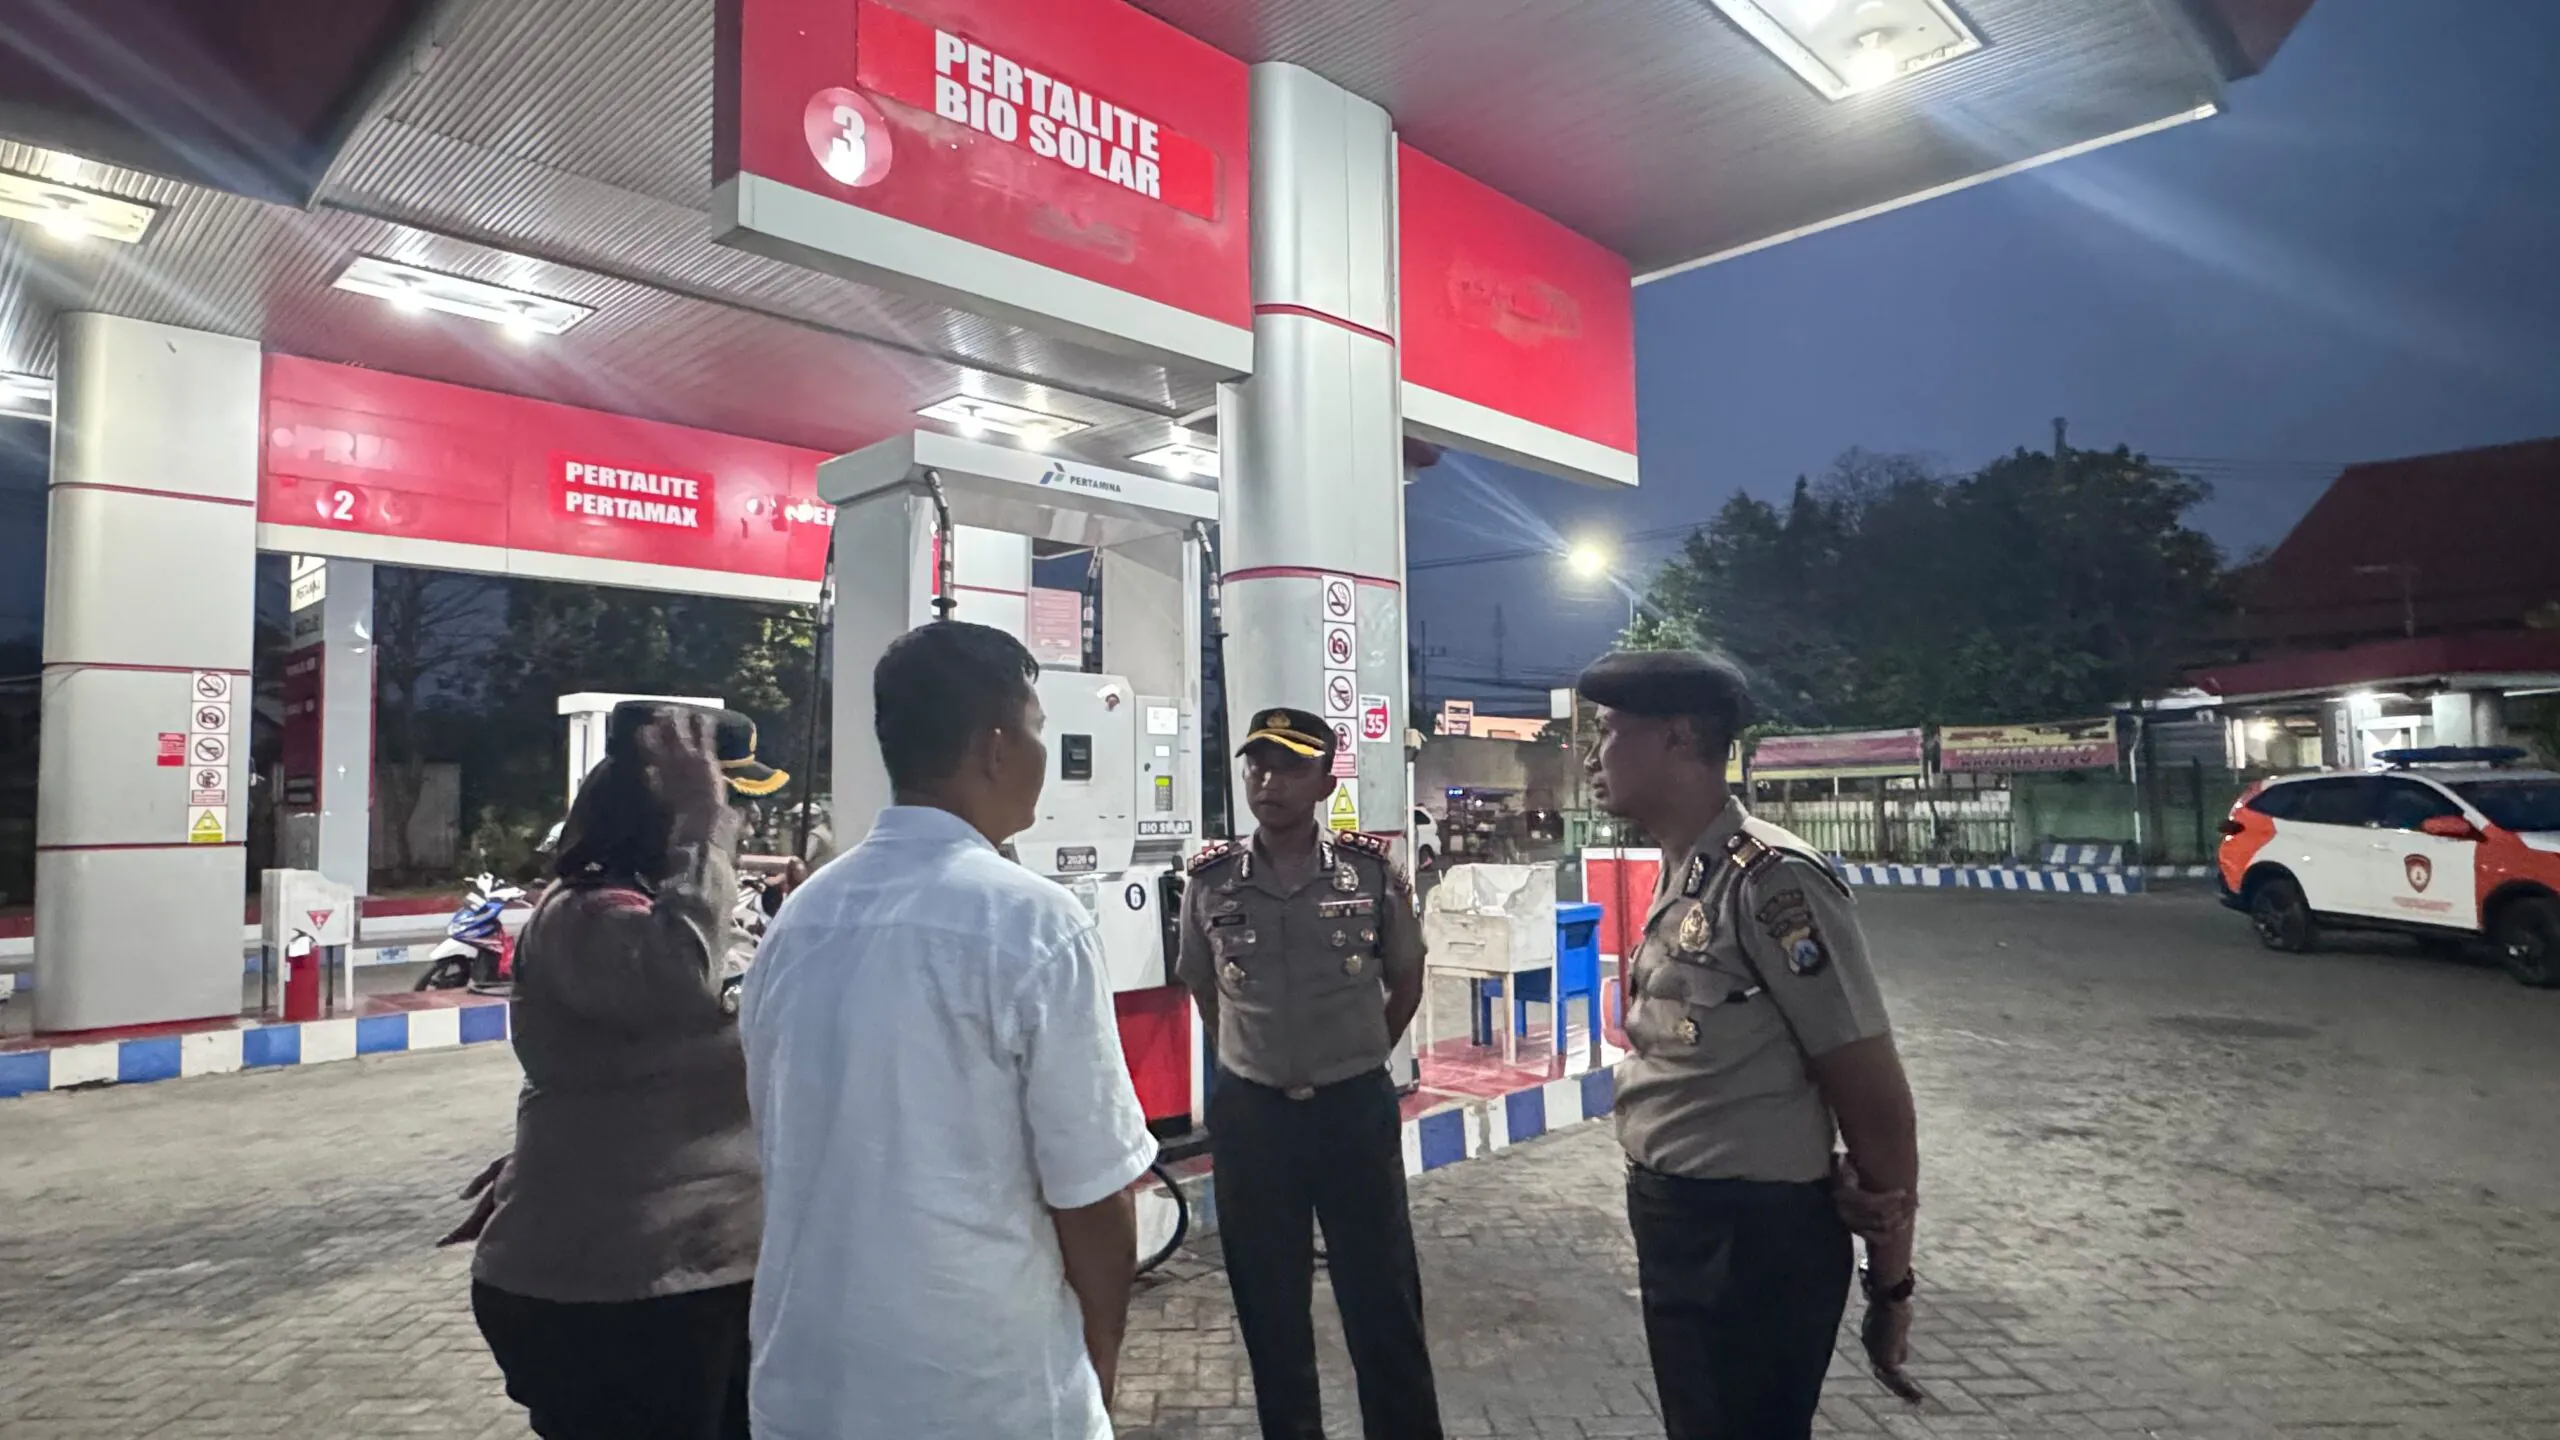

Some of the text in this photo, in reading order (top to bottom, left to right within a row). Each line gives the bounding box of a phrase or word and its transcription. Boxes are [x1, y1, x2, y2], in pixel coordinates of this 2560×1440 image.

[935, 29, 1159, 161] PERTALITE
[831, 104, 866, 185] 3
[935, 74, 1161, 200] BIO SOLAR
[565, 460, 698, 500] PERTALITE
[1070, 475, 1121, 492] PERTAMINA
[332, 490, 355, 521] 2
[565, 490, 698, 529] PERTAMAX
[1130, 886, 1142, 905] 6
